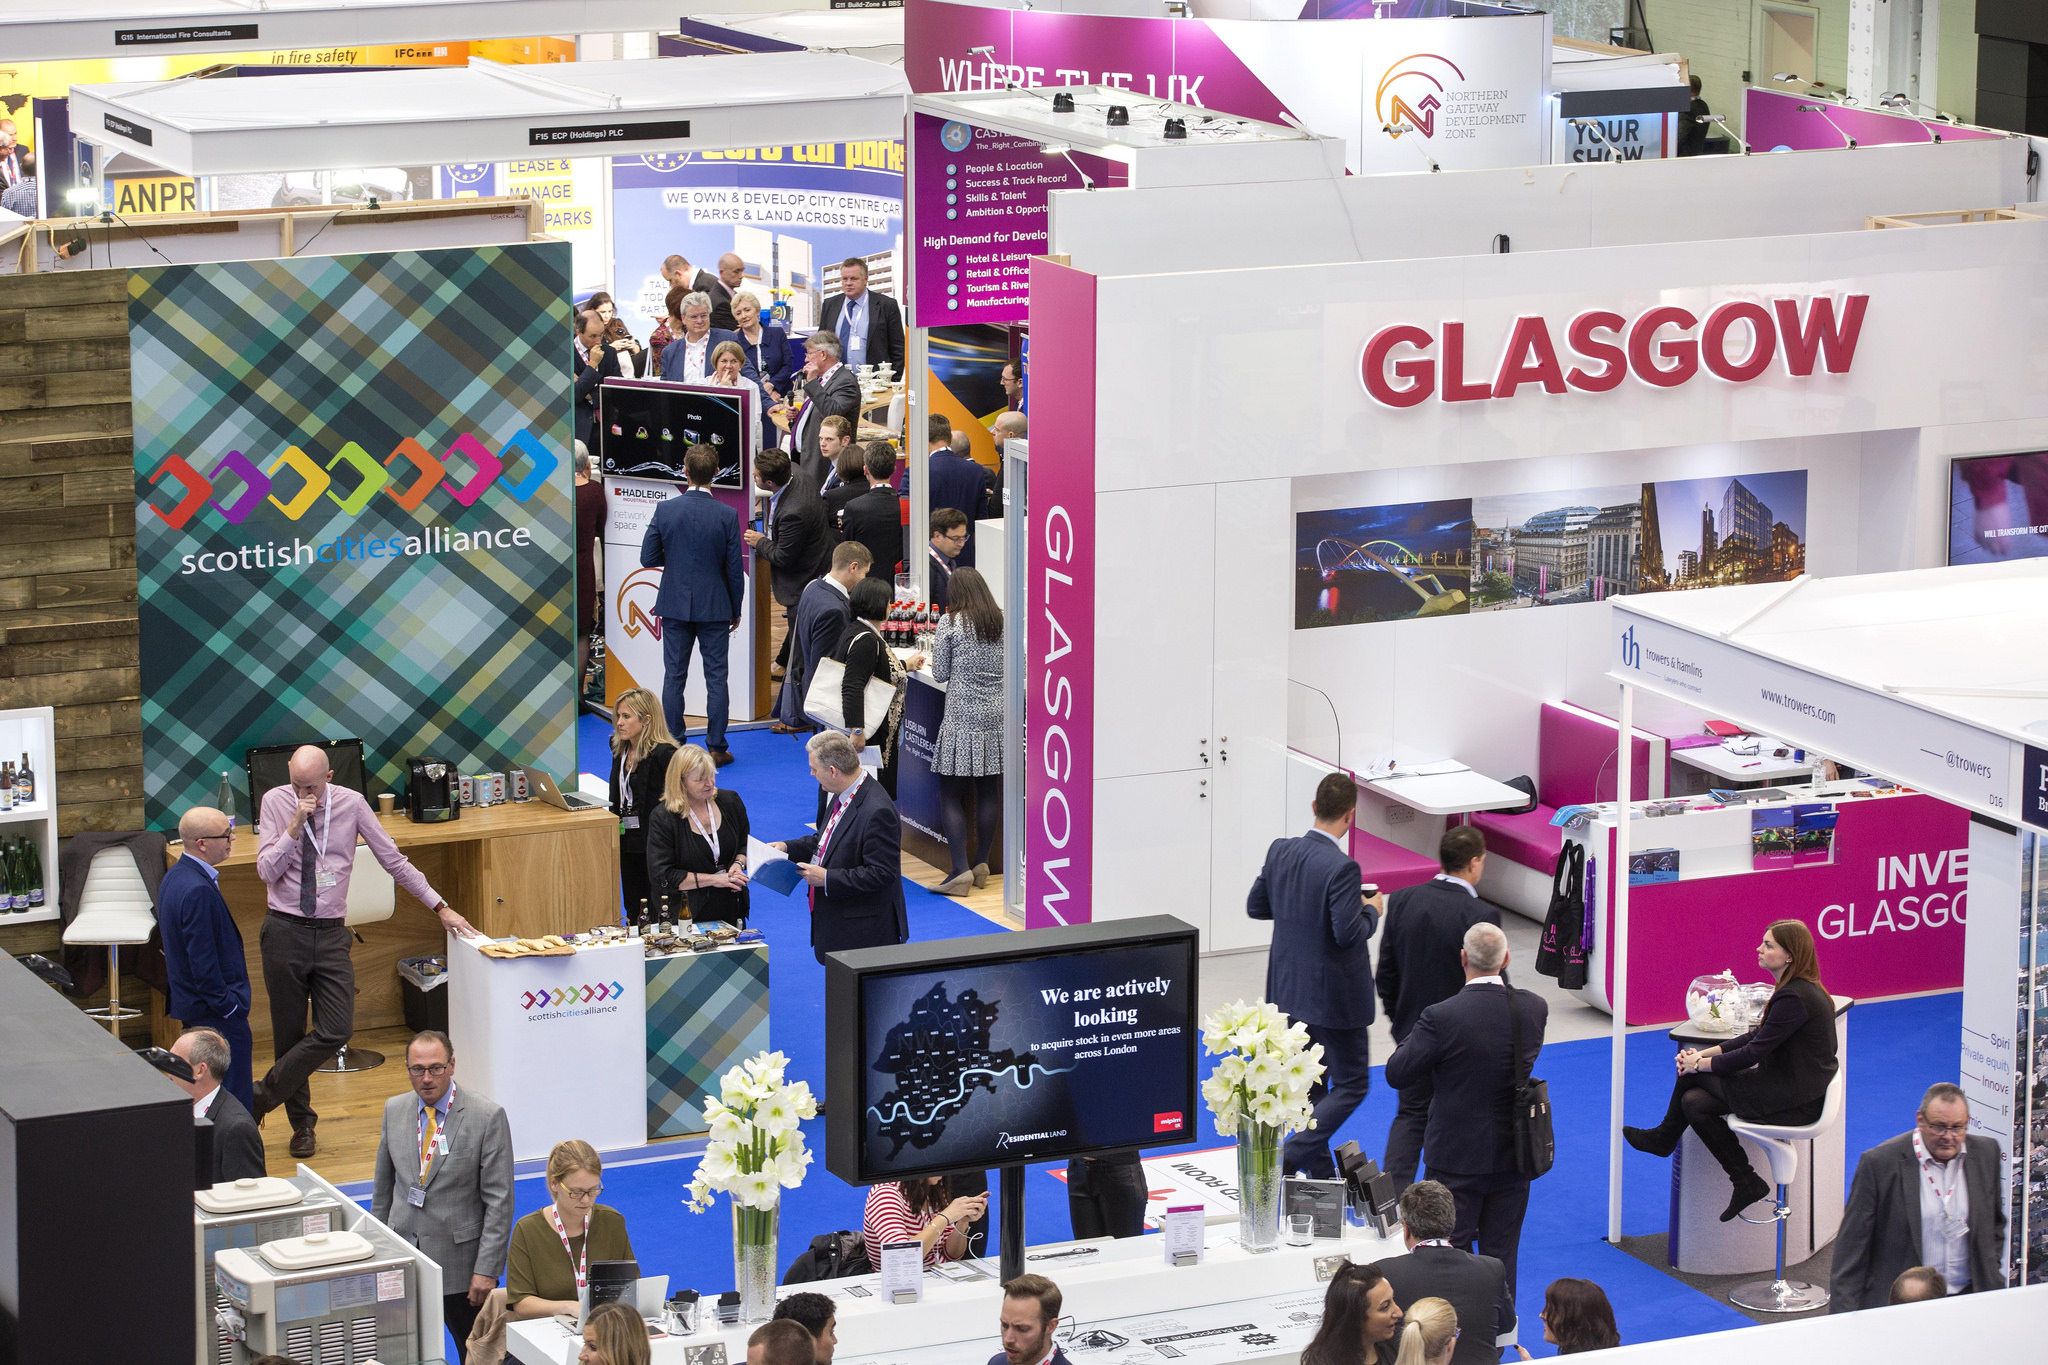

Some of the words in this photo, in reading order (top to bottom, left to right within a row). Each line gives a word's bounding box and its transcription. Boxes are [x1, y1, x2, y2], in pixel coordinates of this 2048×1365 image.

[137, 32, 177, 40] International
[193, 30, 232, 38] Consultants
[271, 51, 283, 64] in
[289, 50, 310, 63] fire
[316, 49, 357, 64] safety
[395, 48, 415, 58] IFC
[1446, 90, 1508, 101] NORTHERN
[1445, 102, 1500, 114] GATEWAY
[1445, 114, 1526, 127] DEVELOPMENT
[535, 133, 549, 141] F15
[552, 132, 568, 140] ECP
[569, 129, 607, 140] (Holdings)
[608, 129, 624, 137] PLC
[1445, 128, 1476, 139] ZONE
[1574, 119, 1639, 145] YOUR
[509, 159, 555, 173] LEASE
[559, 158, 570, 170] &
[965, 164, 994, 175] People
[996, 163, 1004, 172] &
[1005, 161, 1043, 172] Location
[965, 179, 1001, 188] Success
[1002, 177, 1010, 186] &
[1012, 175, 1036, 185] Track
[1037, 174, 1068, 184] Record
[118, 182, 195, 213] ANPR
[509, 184, 572, 200] MANAGE
[965, 193, 989, 203] Skills
[991, 192, 998, 201] &
[1000, 190, 1027, 200] Talent
[666, 192, 689, 204] WE
[693, 192, 727, 204] OWN
[732, 192, 740, 204] &
[744, 193, 805, 205] DEVELOP
[809, 195, 835, 208] CITY
[839, 197, 880, 212] CENTRE
[883, 202, 901, 216] CAR
[544, 211, 592, 227] PARKS
[693, 209, 740, 220] PARKS
[743, 209, 752, 221] &
[757, 210, 793, 222] LAND
[796, 211, 846, 225] ACROSS
[850, 215, 869, 228] THE
[872, 217, 886, 230] UK
[965, 207, 1004, 218] Ambition
[1006, 206, 1014, 215] &
[923, 235, 947, 250] High
[949, 233, 991, 246] Demand
[994, 231, 1010, 242] for
[1012, 230, 1049, 242] Develo
[966, 254, 990, 264] Hotel
[992, 253, 999, 262] &
[1001, 252, 1032, 262] Leisure
[966, 268, 992, 279] Retail
[993, 268, 1001, 277] &
[1002, 266, 1029, 276] Office
[650, 281, 670, 289] TAL
[966, 284, 1000, 293] Tourism
[1001, 282, 1009, 291] &
[966, 296, 1029, 308] Manufacturing
[1361, 294, 1870, 408] GLASGOW
[687, 413, 702, 421] Photo
[621, 488, 667, 500] HADLEIGH
[614, 510, 647, 520] network
[614, 521, 637, 531] space
[1984, 530, 1997, 538] WILL
[1997, 526, 2028, 537] TRANSFORM
[2029, 525, 2039, 534] THE
[181, 526, 532, 575] scottishcitiesalliance
[1621, 624, 1641, 670] th
[1646, 648, 1670, 669] trowers
[1671, 657, 1676, 669] &
[1676, 657, 1703, 679] hamlins
[1761, 687, 1836, 725] www.trowers.com
[1043, 505, 1074, 927] GLASGOW
[905, 718, 927, 737] LISBURN
[1946, 750, 1992, 779] @trowers
[1989, 794, 2004, 808] D16
[1877, 848, 1969, 891] INVE
[1041, 988, 1069, 1006] We
[1073, 987, 1102, 1002] are
[1105, 976, 1171, 998] actively
[528, 1005, 618, 1022] scottishcitiesalliance
[1074, 1006, 1138, 1028] looking
[1030, 1043, 1040, 1052] to
[1041, 1037, 1074, 1051] acquire
[1075, 1035, 1099, 1046] stock
[1101, 1033, 1110, 1043] in
[1111, 1032, 1132, 1042] even
[1134, 1029, 1157, 1039] more
[1158, 1026, 1181, 1036] areas
[1074, 1050, 1102, 1060] across
[1104, 1044, 1138, 1056] London
[1961, 1043, 1985, 1063] Private
[1985, 1057, 2010, 1075] equity
[1170, 1162, 1229, 1188] ROOM
[1191, 1328, 1234, 1338] looking
[1235, 1325, 1251, 1333] for
